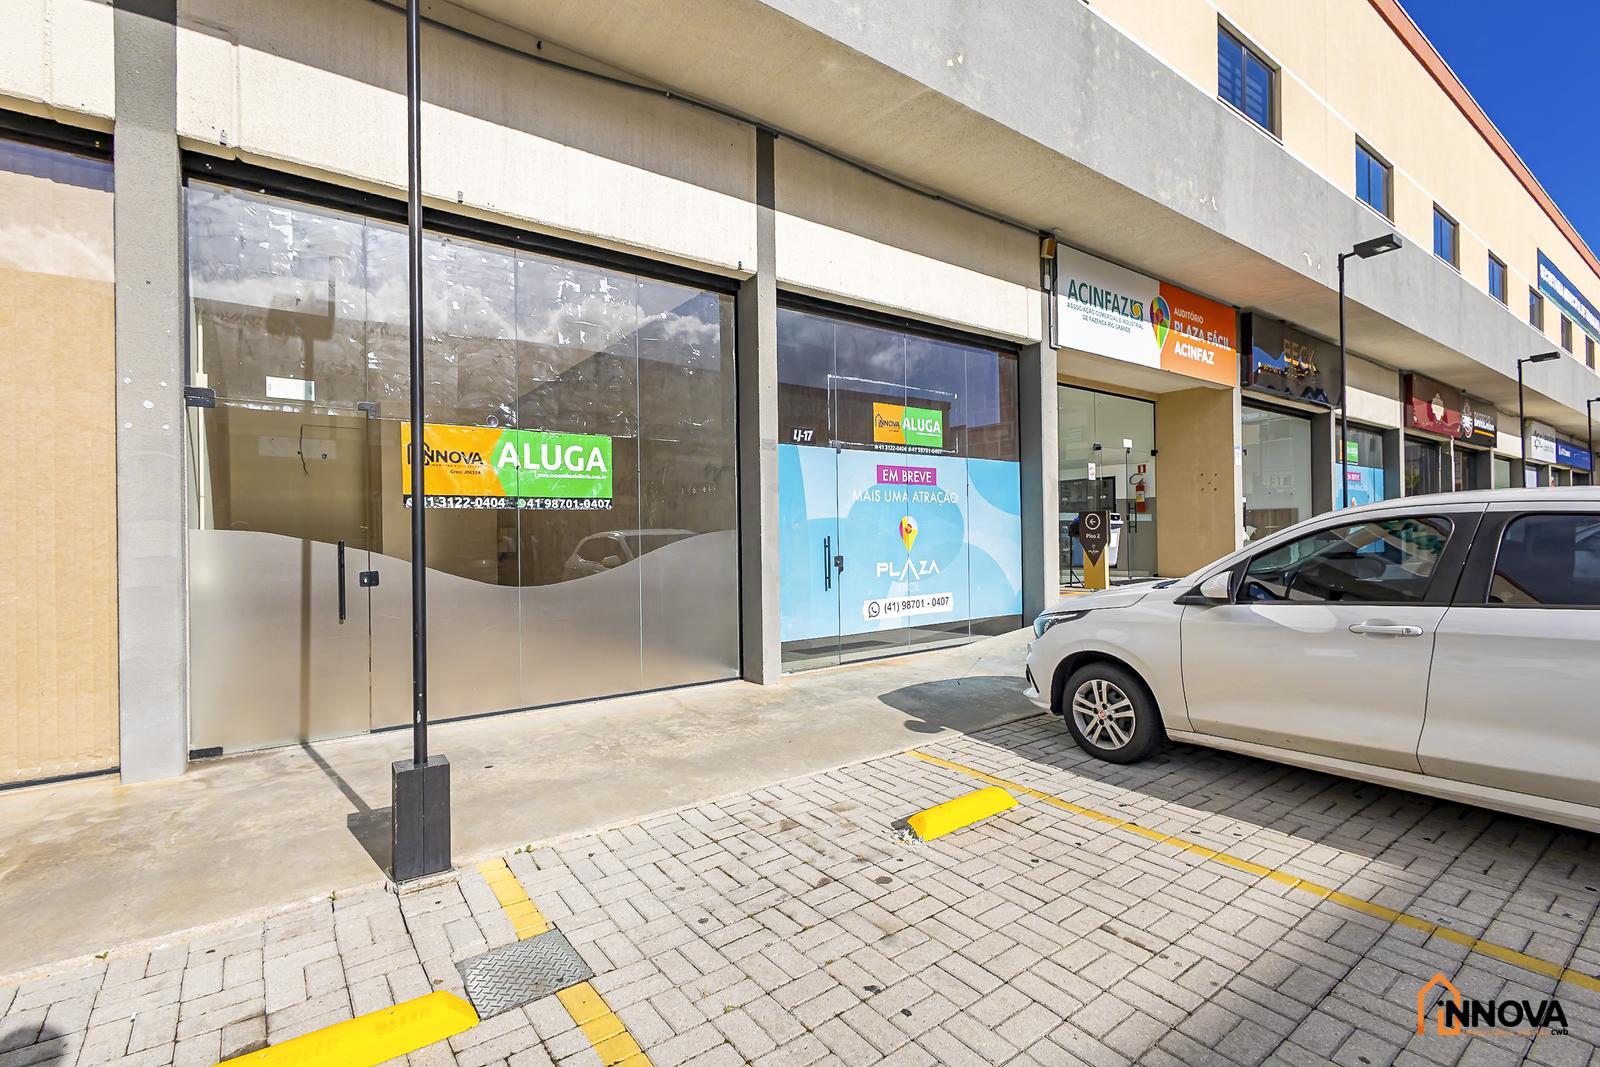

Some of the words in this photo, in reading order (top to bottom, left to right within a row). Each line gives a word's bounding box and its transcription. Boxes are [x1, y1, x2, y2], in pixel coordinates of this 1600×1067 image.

[1067, 279, 1129, 317] ACINFAZ
[1174, 307, 1203, 324] AUDITÓRIO
[1174, 320, 1206, 343] PLAZA
[1207, 330, 1232, 351] FÁCIL
[1174, 341, 1214, 365] ACINFAZ
[903, 417, 941, 433] ALUGA
[497, 441, 608, 473] ALUGA
[882, 469, 899, 482] EM
[902, 469, 932, 484] BREVE
[439, 496, 505, 508] 3122-0404
[526, 499, 541, 508] 41
[544, 499, 611, 510] 98701-0407
[853, 490, 881, 503] MAIS
[884, 490, 909, 504] UMA
[911, 489, 959, 507] ATRAÇÃO
[876, 557, 940, 581] PLAZA
[883, 601, 900, 613] (41)
[902, 599, 925, 612] 98701
[932, 597, 950, 609] 0407
